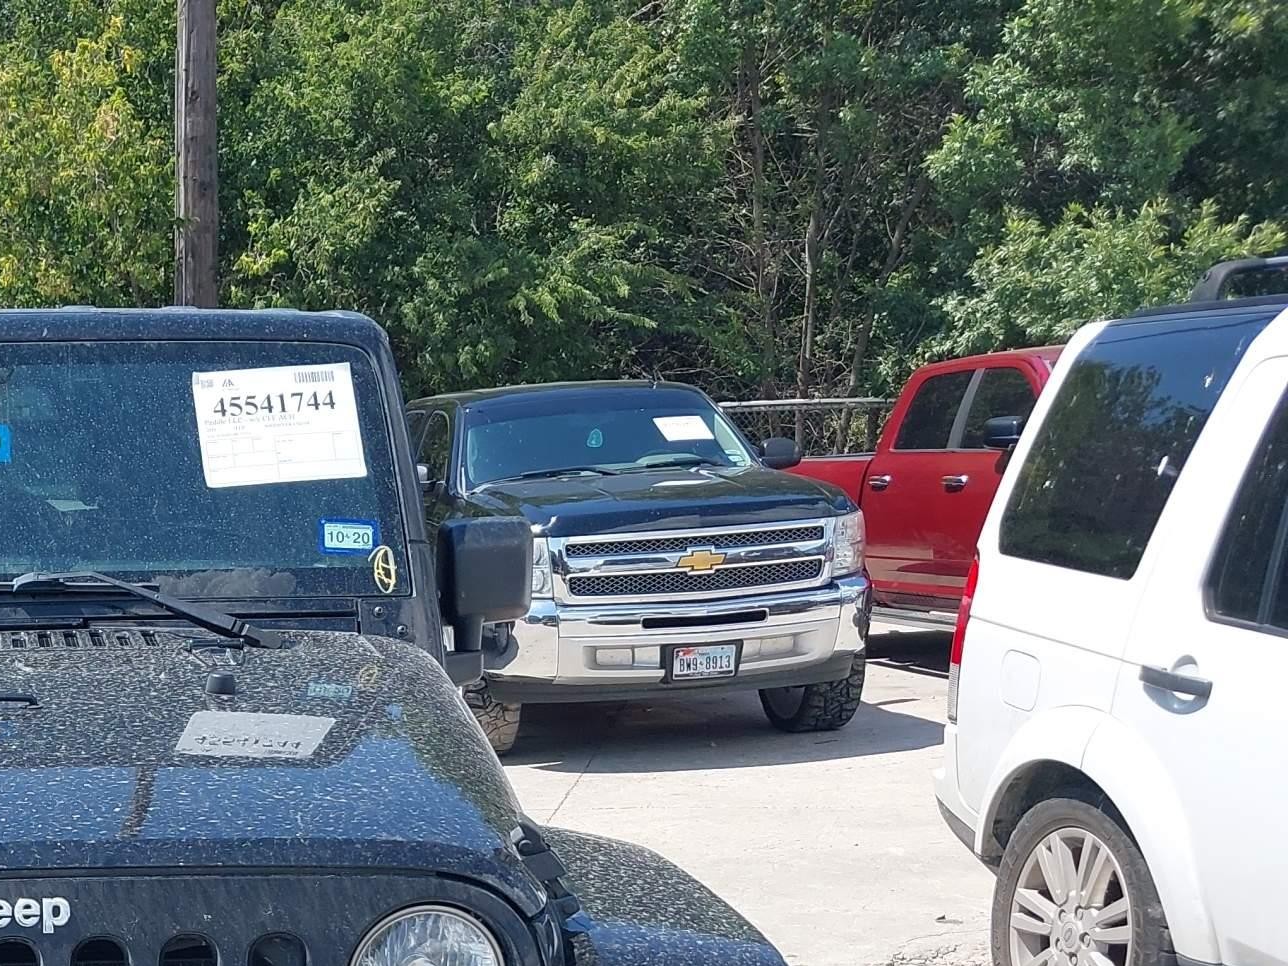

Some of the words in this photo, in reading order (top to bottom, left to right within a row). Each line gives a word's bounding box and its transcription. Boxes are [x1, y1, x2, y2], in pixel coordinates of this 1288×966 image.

[213, 389, 336, 417] 45541744
[327, 530, 345, 544] 10
[352, 532, 370, 544] 20
